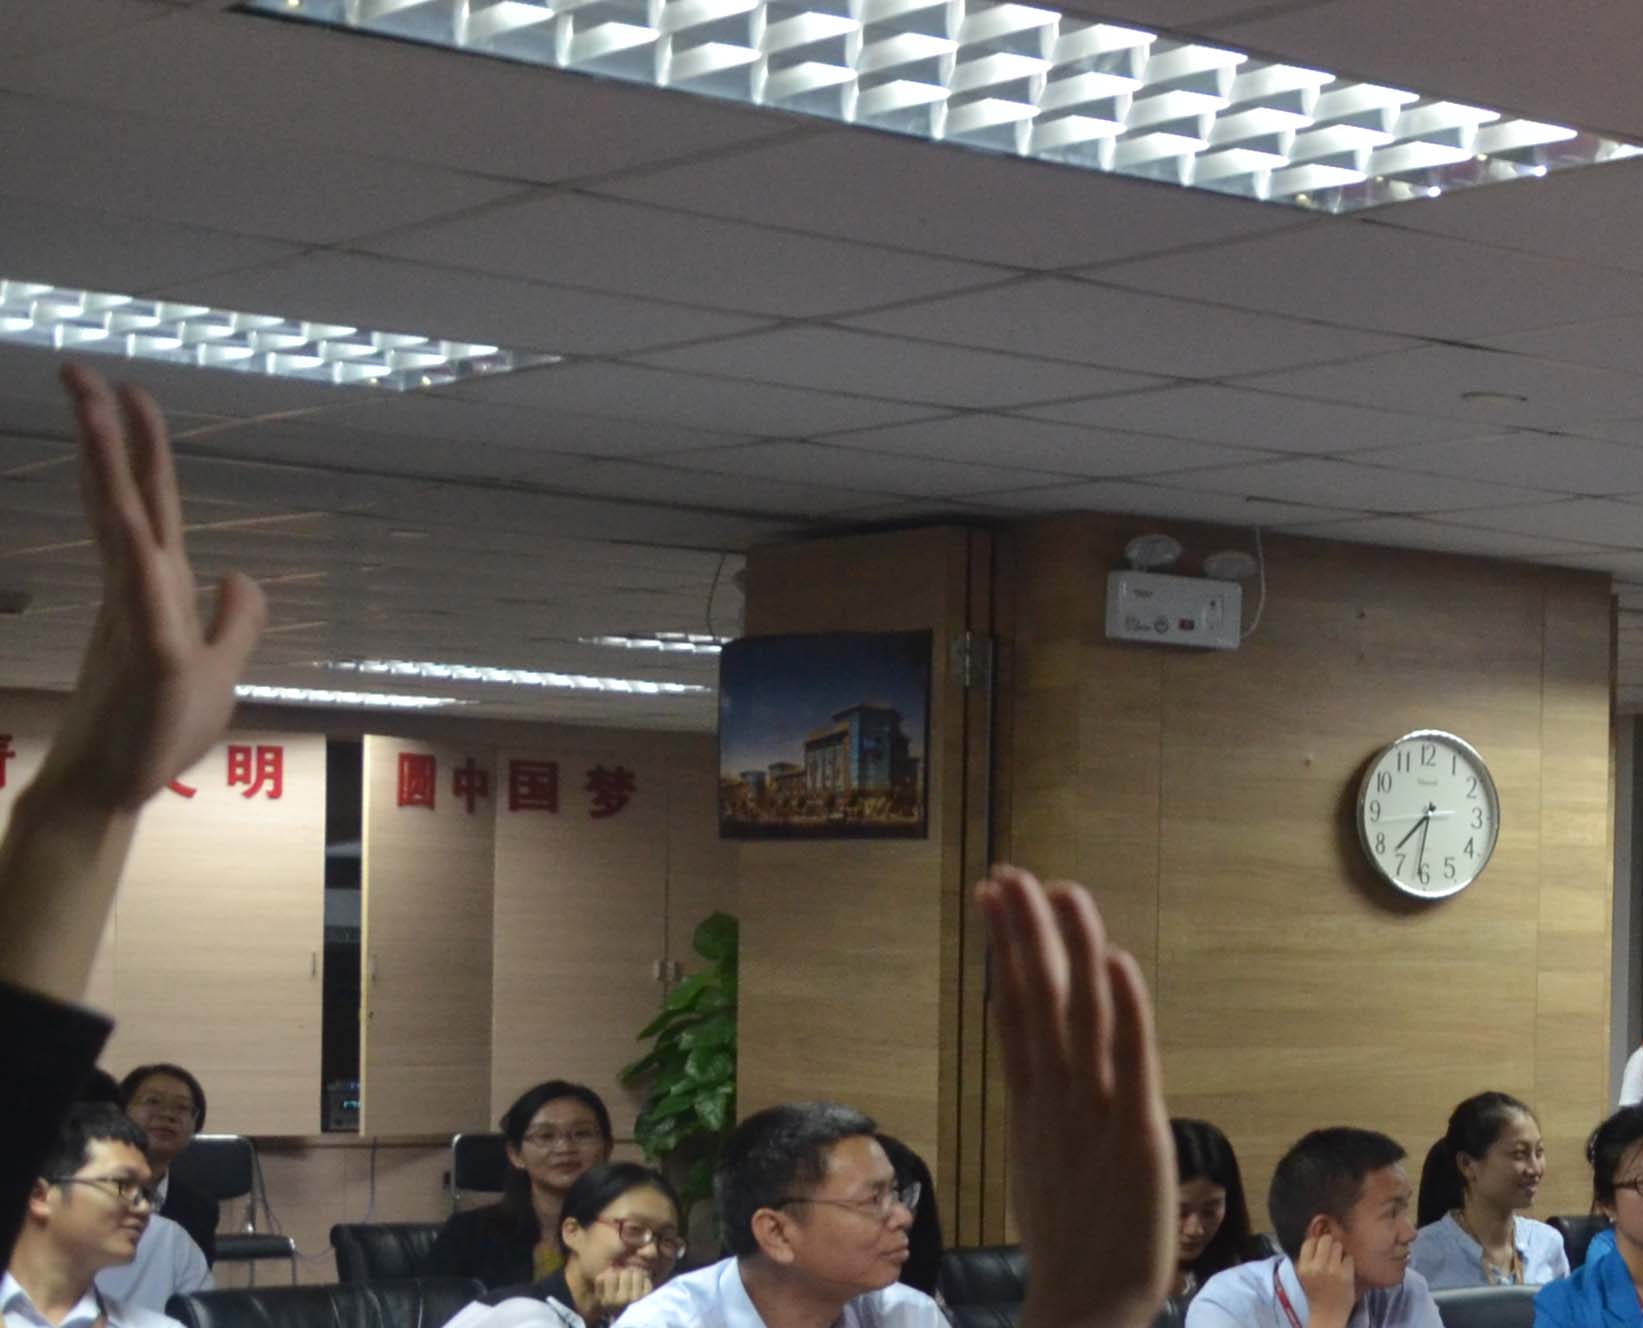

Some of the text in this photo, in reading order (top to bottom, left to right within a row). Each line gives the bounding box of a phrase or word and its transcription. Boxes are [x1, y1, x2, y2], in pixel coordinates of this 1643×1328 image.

[1396, 752, 1411, 773] 11
[1420, 744, 1437, 767] 12
[1451, 755, 1457, 775] 1
[1376, 771, 1393, 793] 10
[1466, 776, 1478, 799] 2
[1369, 800, 1381, 822] 9
[1471, 807, 1483, 829] 3
[1375, 832, 1386, 854] 8
[1464, 837, 1475, 859] 4
[1395, 853, 1406, 876] 7
[1418, 863, 1431, 886] 6
[1444, 857, 1456, 879] 5
